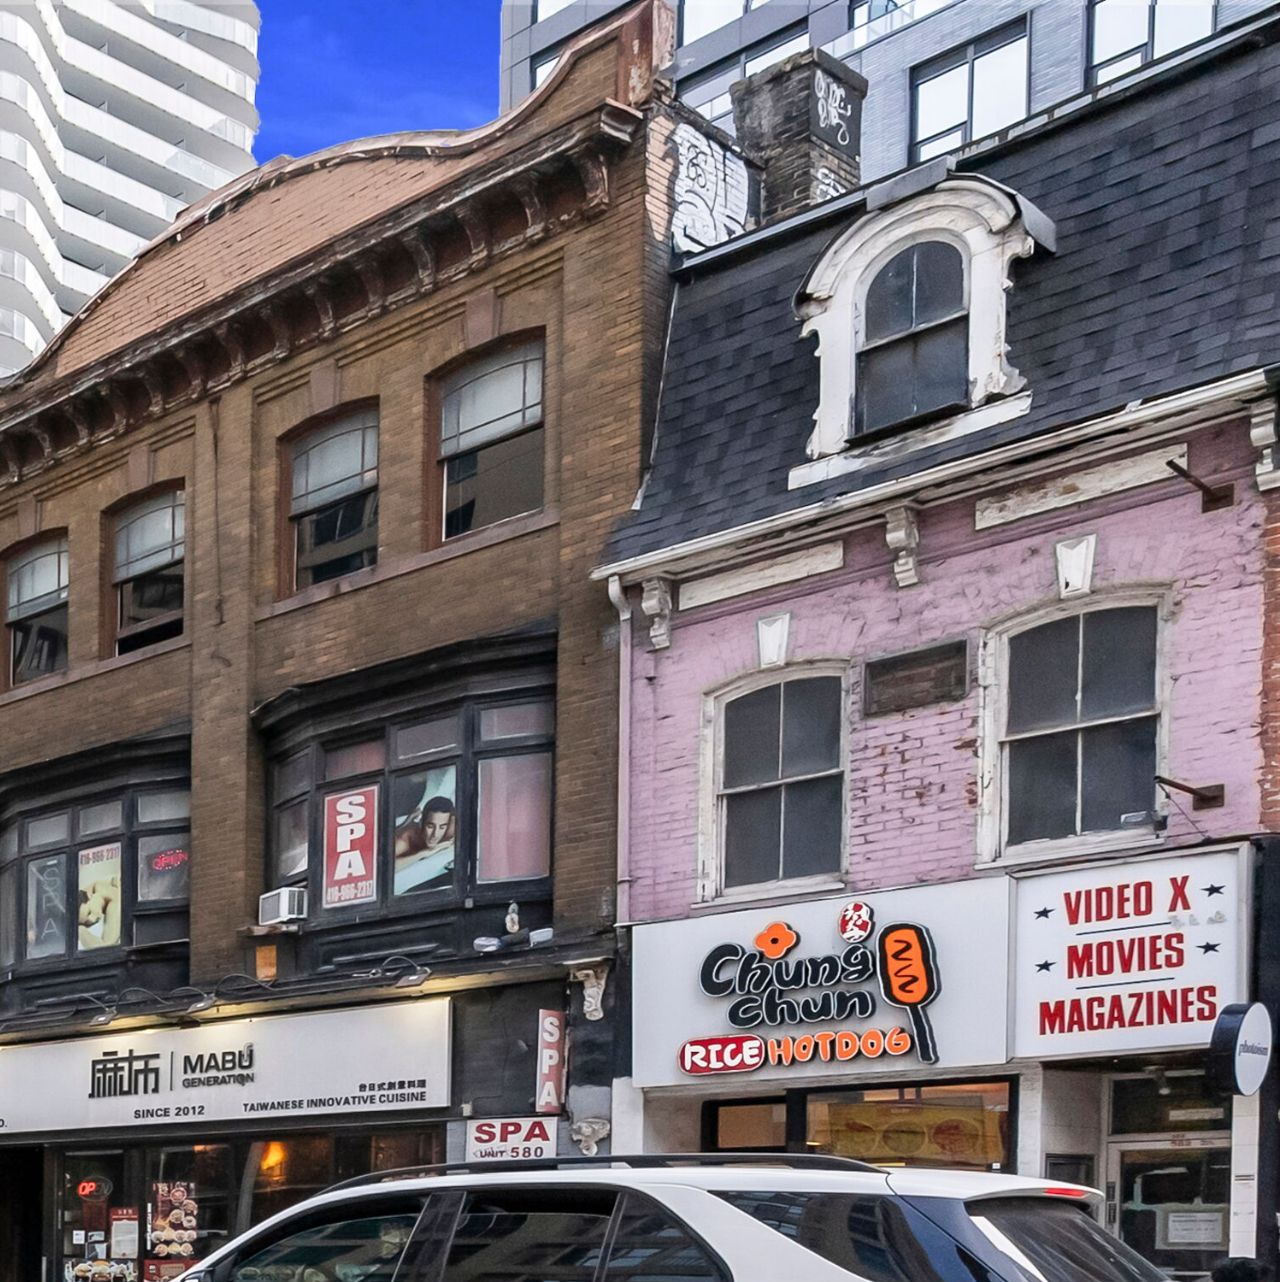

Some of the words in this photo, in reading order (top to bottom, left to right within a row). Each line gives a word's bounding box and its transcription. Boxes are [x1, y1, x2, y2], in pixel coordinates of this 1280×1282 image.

[334, 795, 366, 880] SPA
[1064, 881, 1153, 925] VIDEO
[1168, 875, 1191, 912] X
[700, 943, 874, 997] Chung
[1067, 932, 1184, 979] MOVIES
[1039, 985, 1217, 1035] MAGAZINES
[183, 1049, 254, 1075] MABU
[541, 1017, 560, 1107] SPA
[684, 1040, 761, 1070] RICE
[768, 1026, 911, 1066] HOTDOG
[182, 1073, 254, 1088] GENERATION
[244, 1099, 304, 1113] TAIWANESE
[307, 1094, 376, 1109] INNOVATIVE
[378, 1092, 426, 1104] CUISINE
[134, 1107, 171, 1119] SINCE
[175, 1105, 205, 1117] 2012
[474, 1121, 549, 1143] SPA
[479, 1149, 506, 1158] UNIT
[510, 1146, 544, 1159] 580
